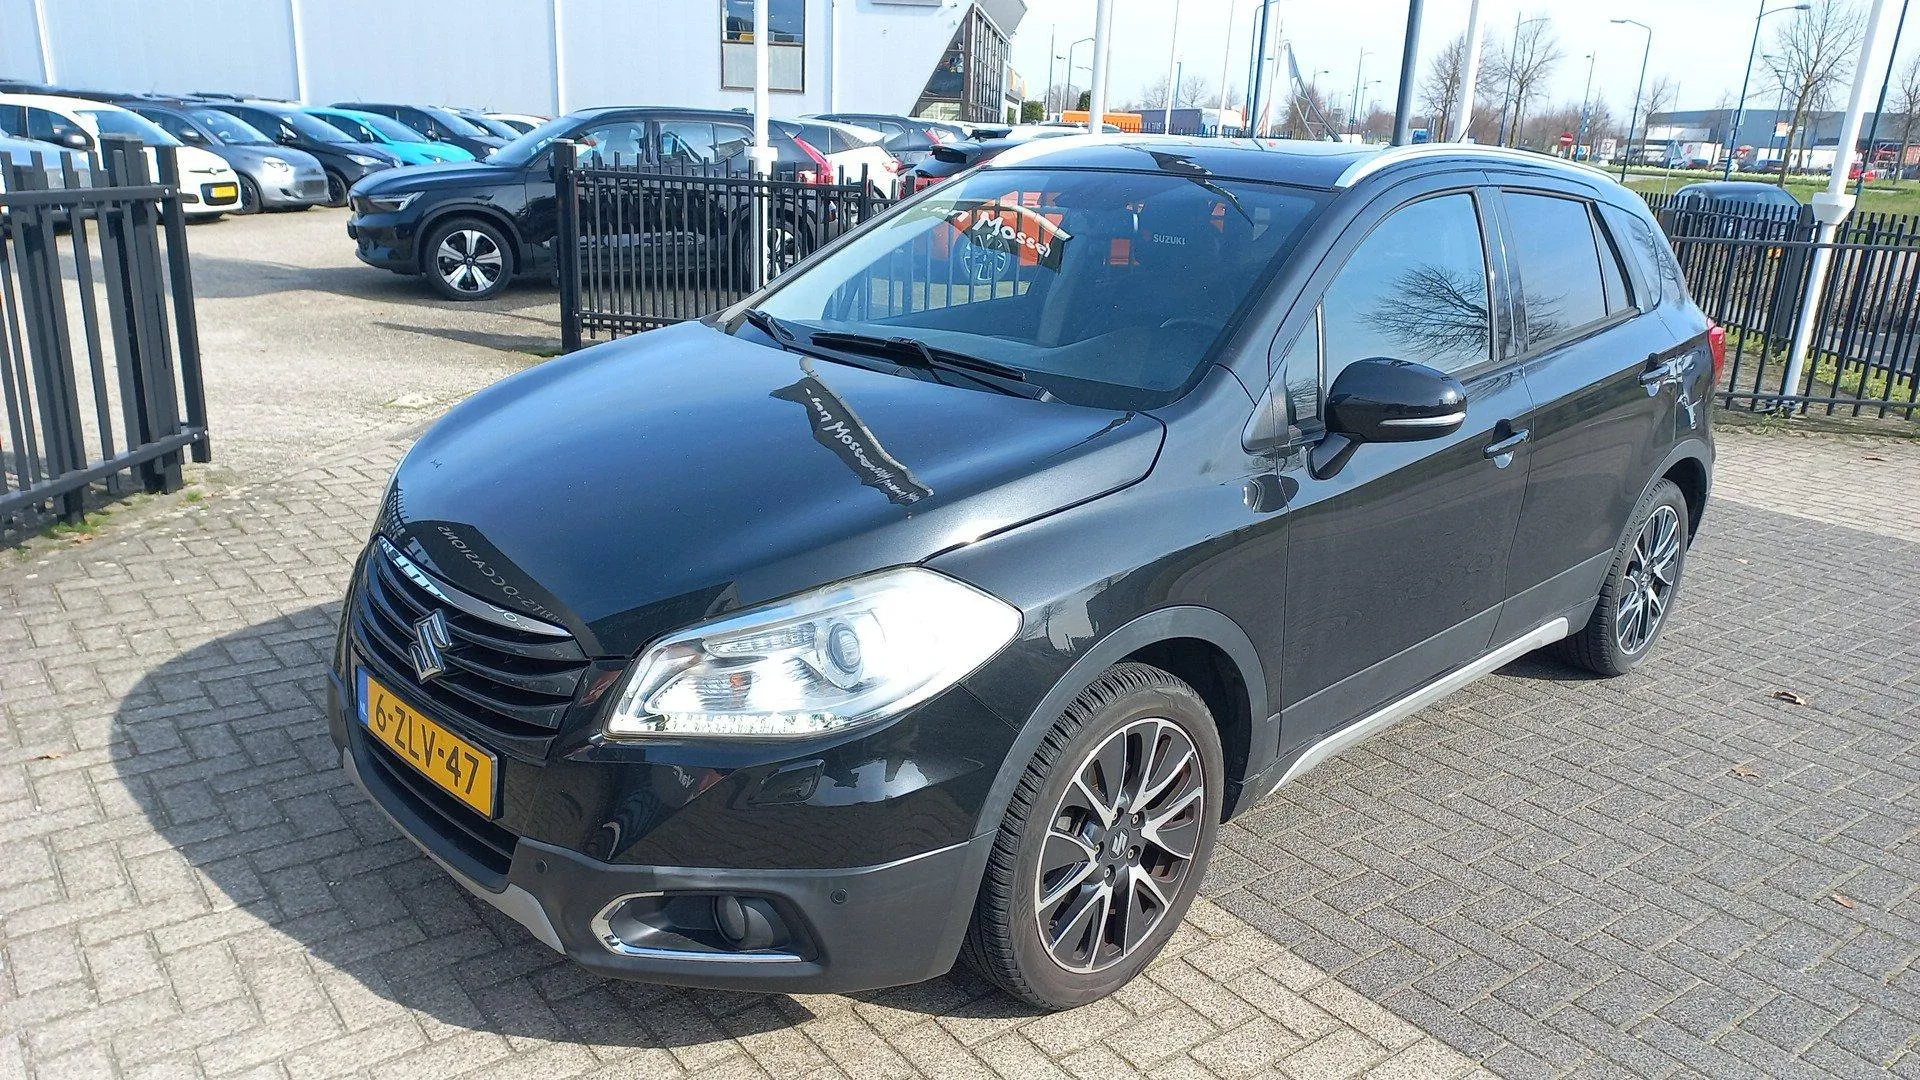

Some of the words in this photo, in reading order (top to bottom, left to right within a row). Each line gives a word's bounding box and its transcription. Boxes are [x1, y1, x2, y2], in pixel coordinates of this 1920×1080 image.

[973, 211, 1052, 258] Mossel
[1153, 233, 1187, 246] SUZUKI
[359, 700, 368, 717] NL
[375, 693, 479, 795] 6-ZLV-47
